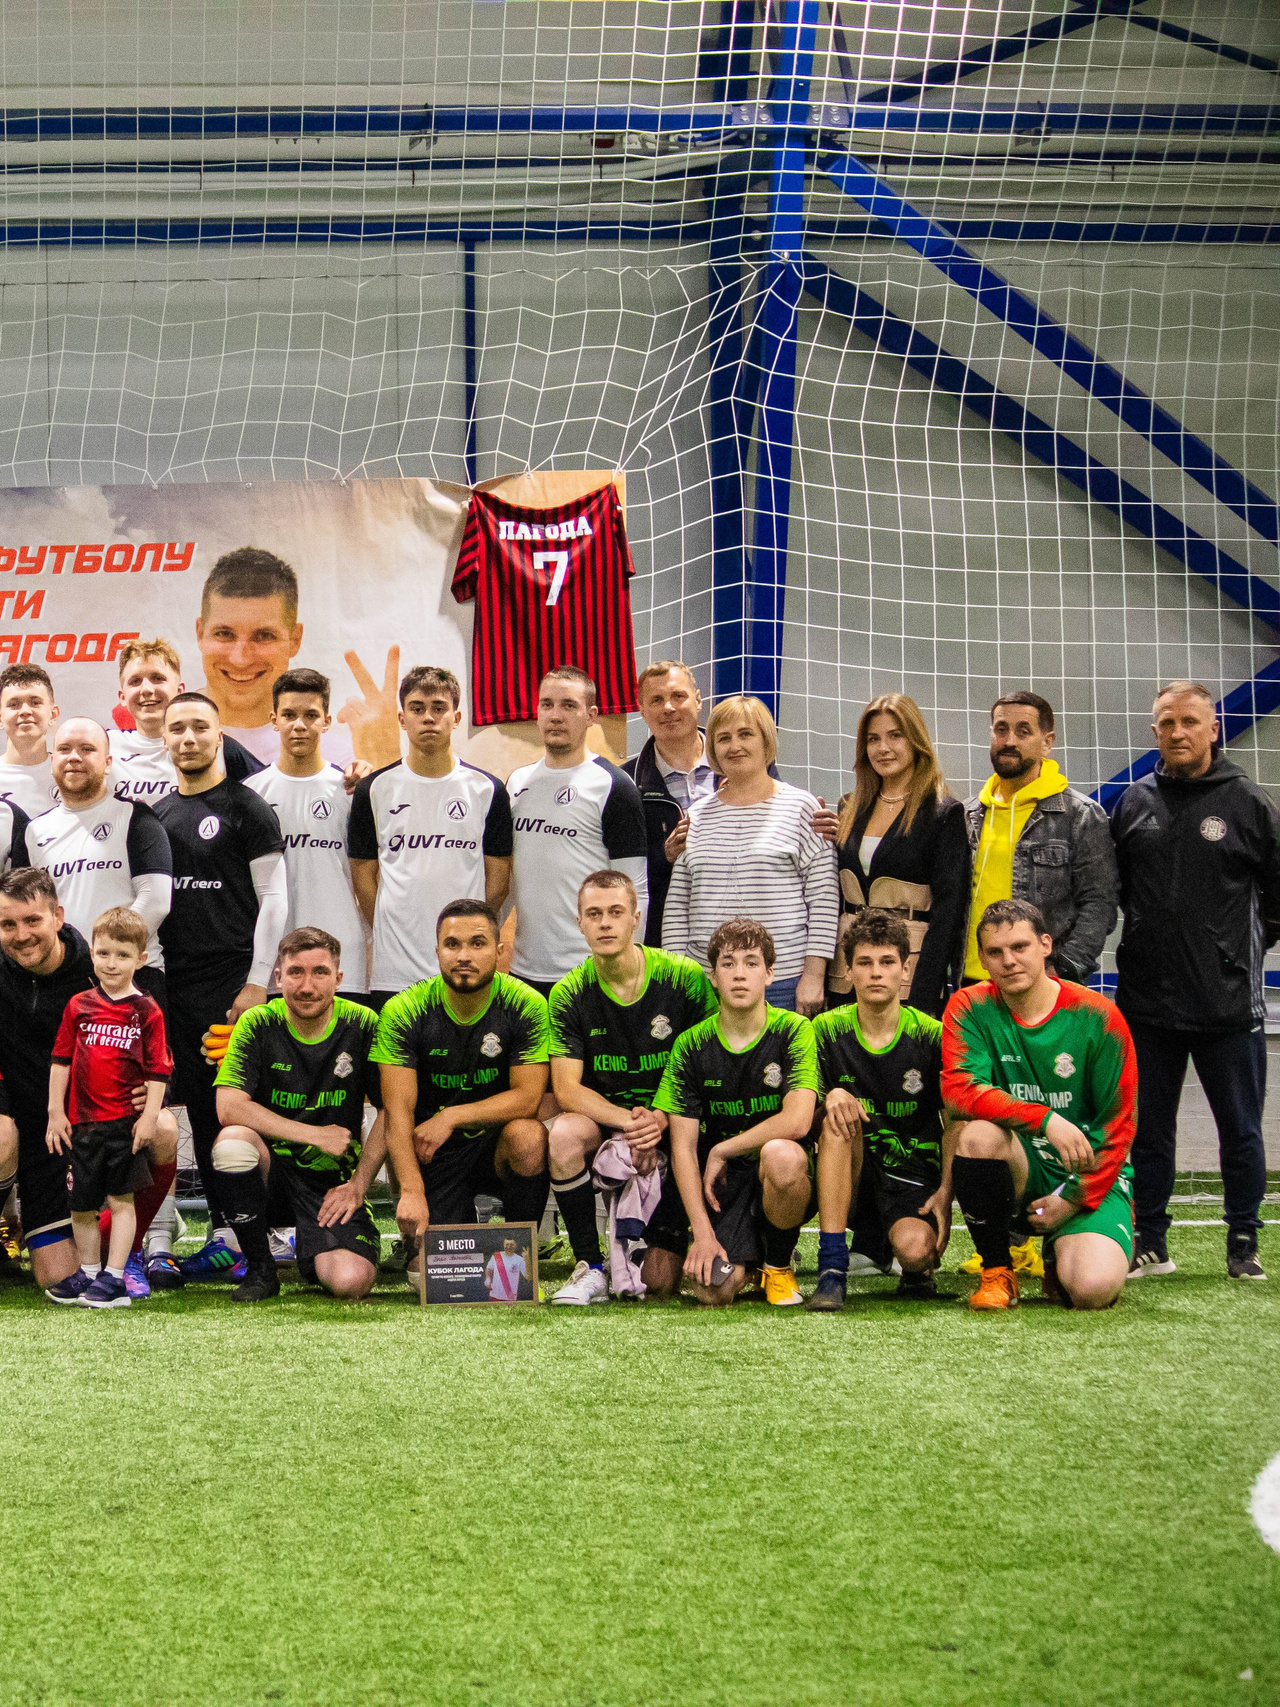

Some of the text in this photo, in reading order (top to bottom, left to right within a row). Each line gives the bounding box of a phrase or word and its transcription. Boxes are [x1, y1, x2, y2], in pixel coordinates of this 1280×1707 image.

[533, 551, 568, 606] 7
[133, 781, 170, 794] UVT
[515, 818, 577, 838] UVT aero
[309, 839, 342, 850] aero
[408, 834, 477, 850] UVT aero
[53, 858, 122, 878] UVT aero
[173, 877, 222, 889] VT aero
[100, 1035, 132, 1050] BETTER
[438, 1239, 475, 1251] 3 МЕСТО
[454, 1266, 484, 1274] ЛАГОДА
